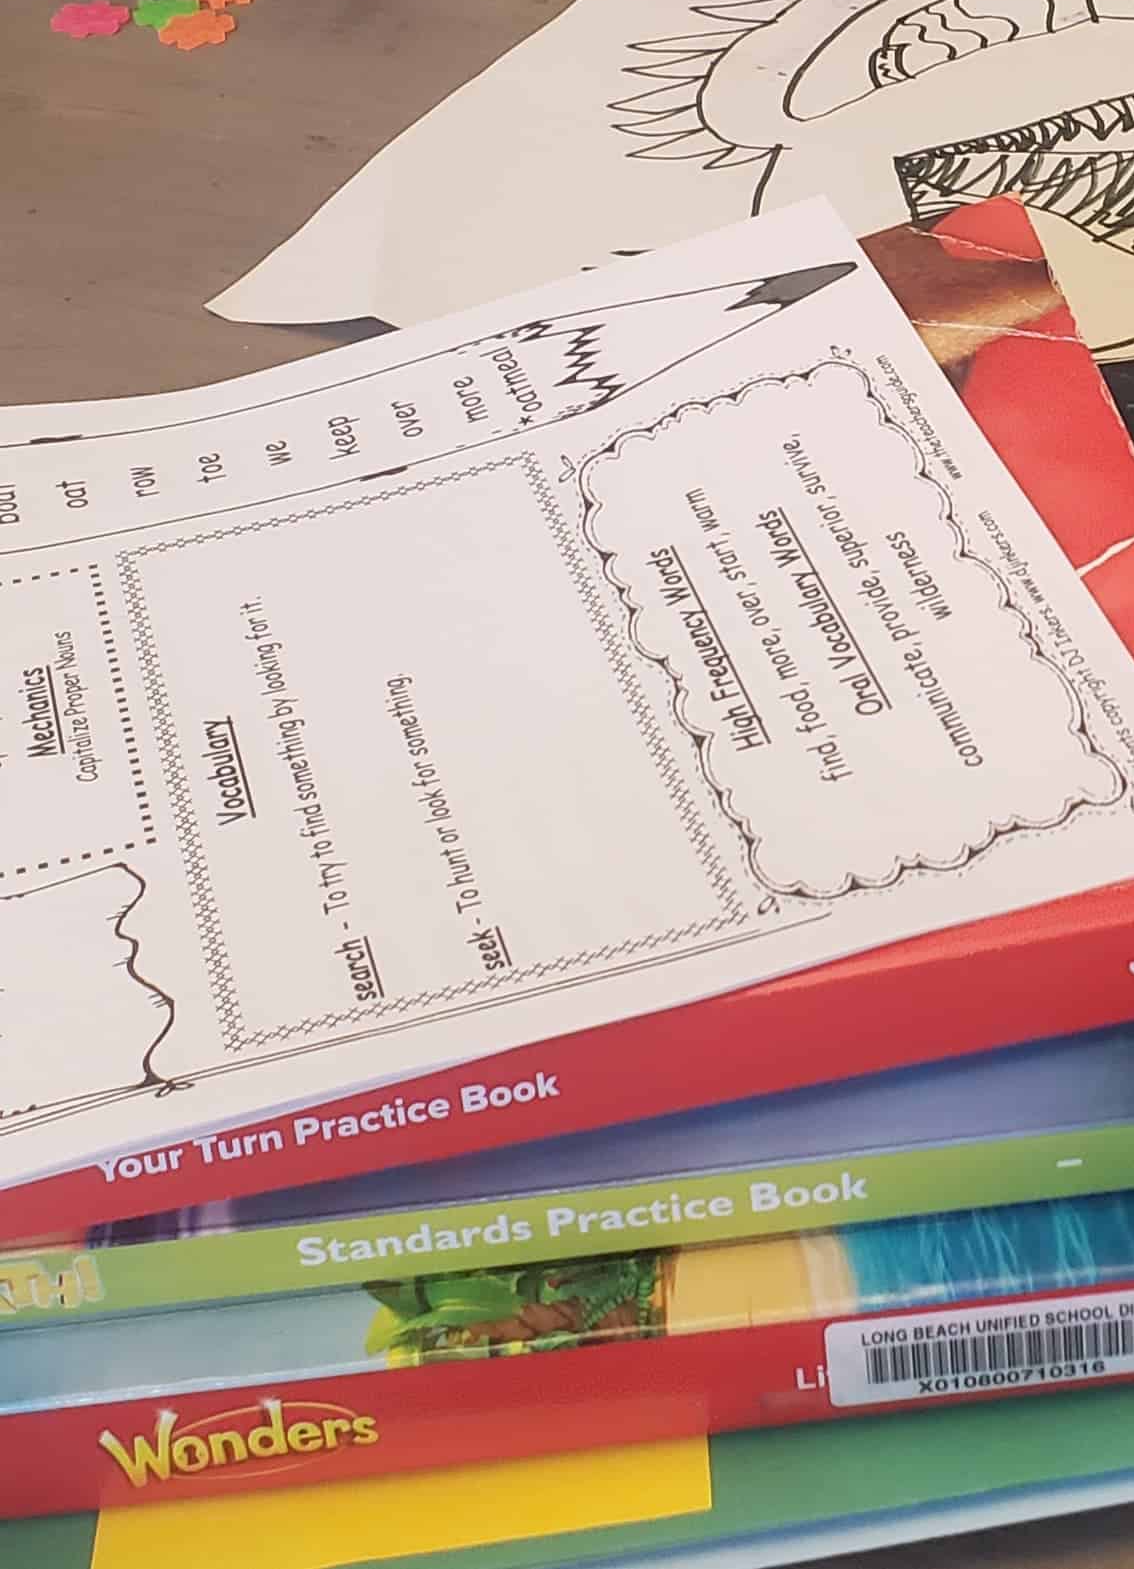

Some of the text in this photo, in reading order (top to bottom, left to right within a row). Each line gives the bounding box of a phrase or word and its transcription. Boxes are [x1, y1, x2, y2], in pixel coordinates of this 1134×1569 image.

[391, 401, 423, 437] over
[453, 376, 488, 423] more
[875, 354, 962, 480] www.theteachersguide.com
[265, 440, 292, 466] we
[328, 416, 360, 460] keep
[130, 466, 159, 497] row
[197, 453, 226, 483] toe
[56, 480, 88, 508] oat
[816, 496, 869, 569] superior,
[886, 531, 952, 620] wilderness
[755, 510, 884, 717] Oral Vocabulary Words
[862, 569, 920, 642] provide,
[244, 618, 272, 640] for
[646, 548, 763, 751] High Frequency Words
[685, 488, 852, 782] find, food, more, over, start, warm
[253, 642, 288, 695] looking
[18, 667, 59, 758] Mechanics
[55, 631, 102, 783] Capitalize Proper Nouns
[267, 698, 299, 719] by
[904, 642, 984, 767] communicate,
[1077, 669, 1122, 726] copyright
[201, 720, 248, 826] Vocabulary
[275, 719, 317, 801] something
[411, 762, 440, 787] for
[293, 803, 330, 837] find
[418, 789, 452, 824] look
[310, 840, 334, 859] to
[437, 827, 459, 844] or
[318, 862, 349, 888] try
[440, 848, 475, 888] hunt
[323, 891, 350, 916] To
[455, 888, 482, 915] To
[334, 939, 377, 1002] search
[467, 927, 506, 973] seek
[98, 1072, 560, 1184] Your Turn Practice Book
[297, 1172, 867, 1267] Standards Practice Book
[861, 1325, 908, 1347] LONG
[913, 1320, 971, 1340] BEACH
[976, 1314, 1040, 1334] UNIFIED
[1045, 1307, 1113, 1326] SCHOOL
[99, 1397, 379, 1488] Wonders
